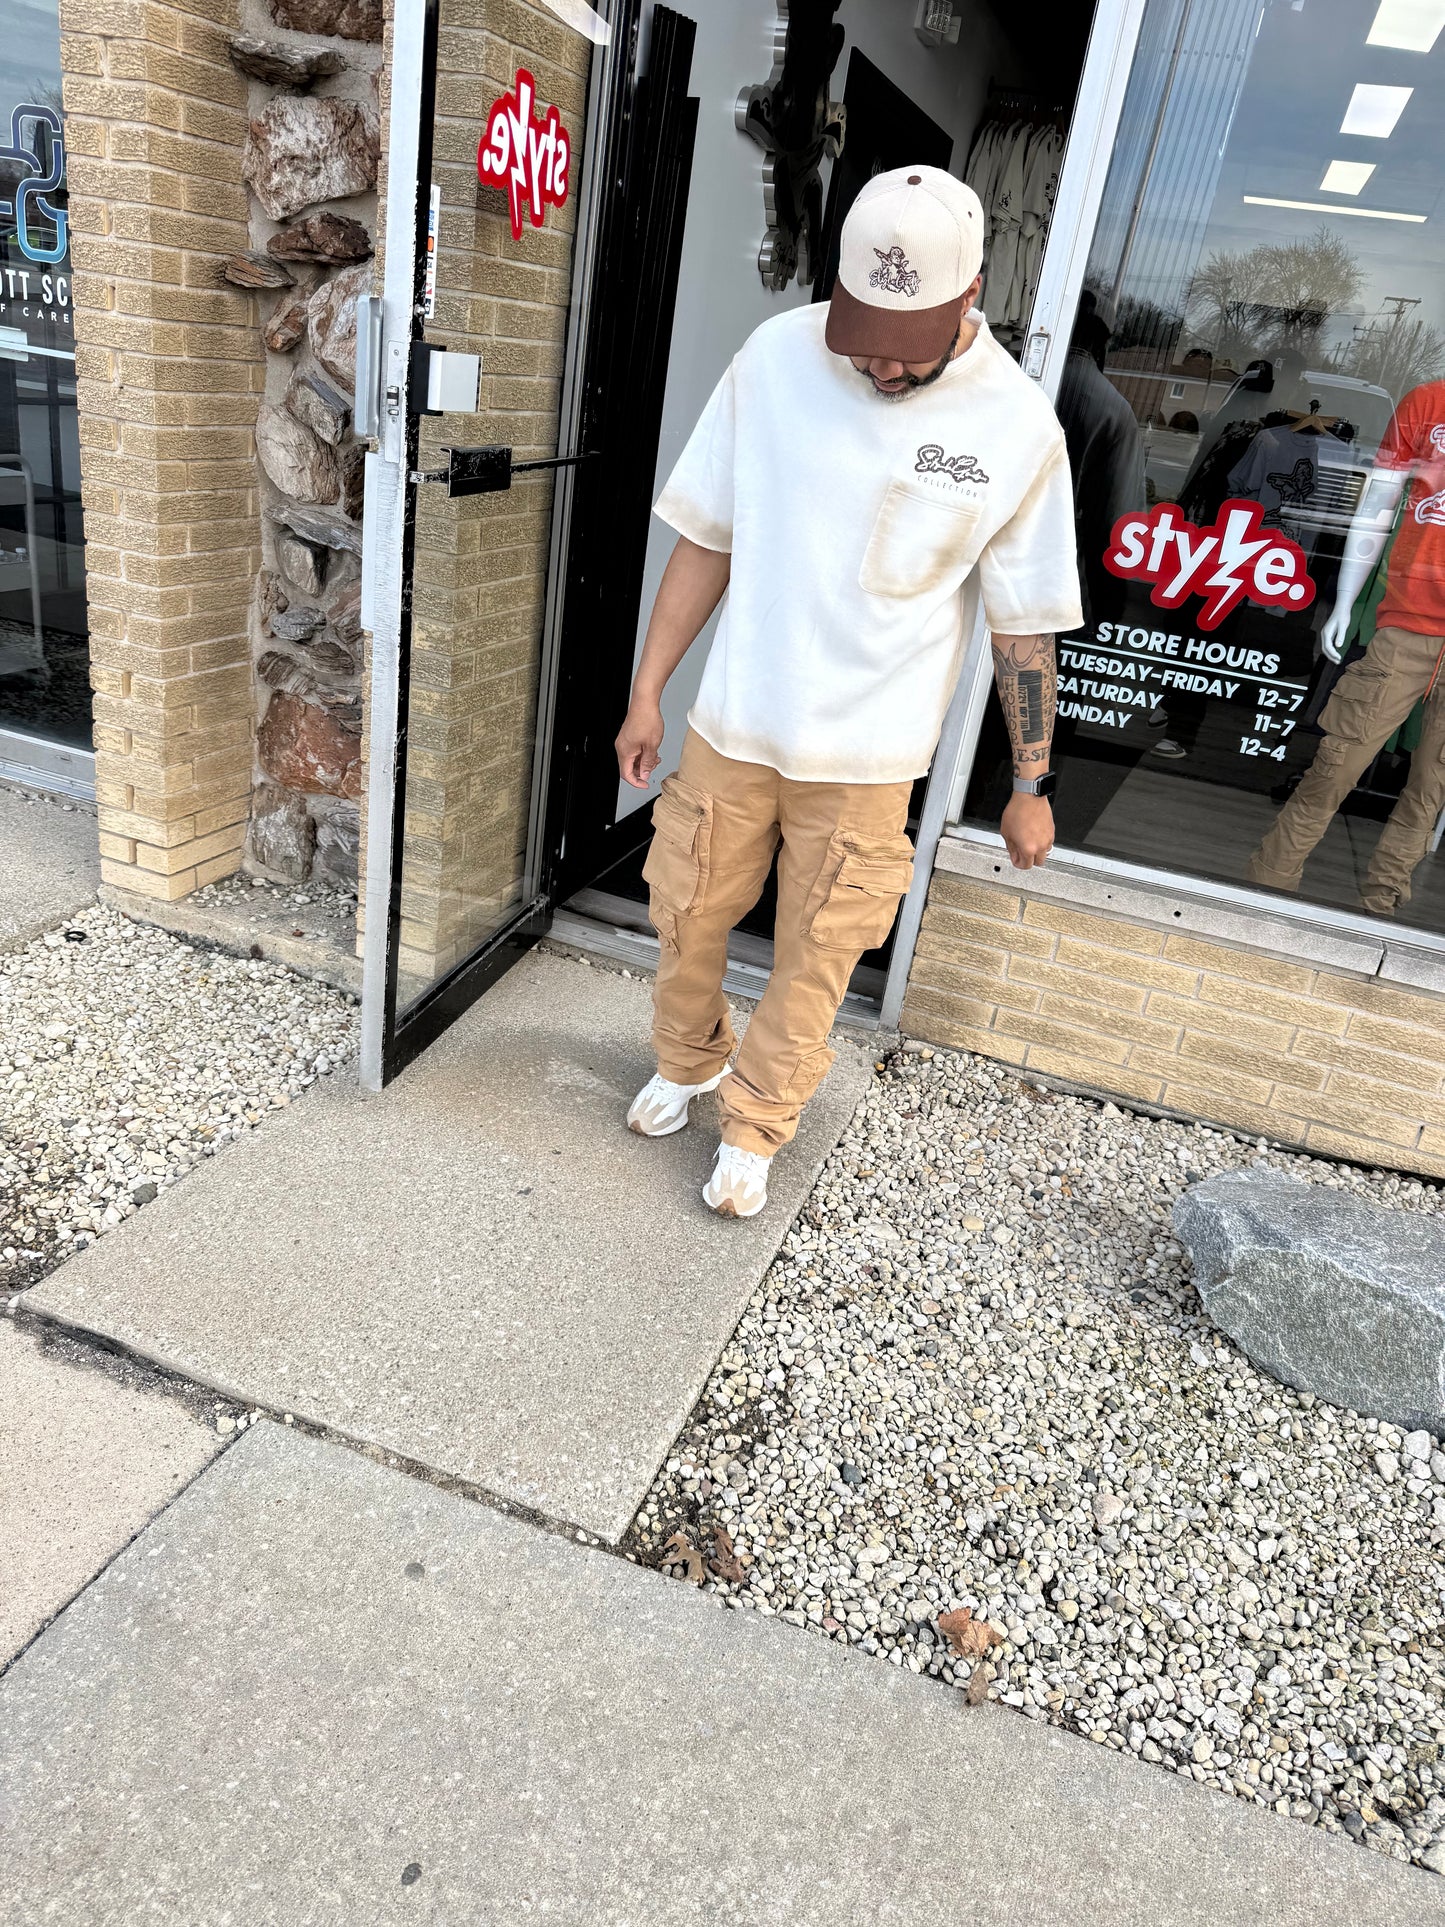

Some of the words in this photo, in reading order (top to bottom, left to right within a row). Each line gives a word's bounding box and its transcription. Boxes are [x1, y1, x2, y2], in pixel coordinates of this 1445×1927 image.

[0, 269, 30, 301] TT
[22, 306, 70, 324] CARE
[917, 474, 978, 498] COLLECTION
[1096, 621, 1182, 656] STORE
[1184, 637, 1281, 675] HOURS
[1059, 649, 1241, 699] TUESDAY-FRIDAY
[1257, 687, 1304, 713] 12-7
[1253, 713, 1297, 737] 11-7
[1239, 736, 1287, 762] 12-4
